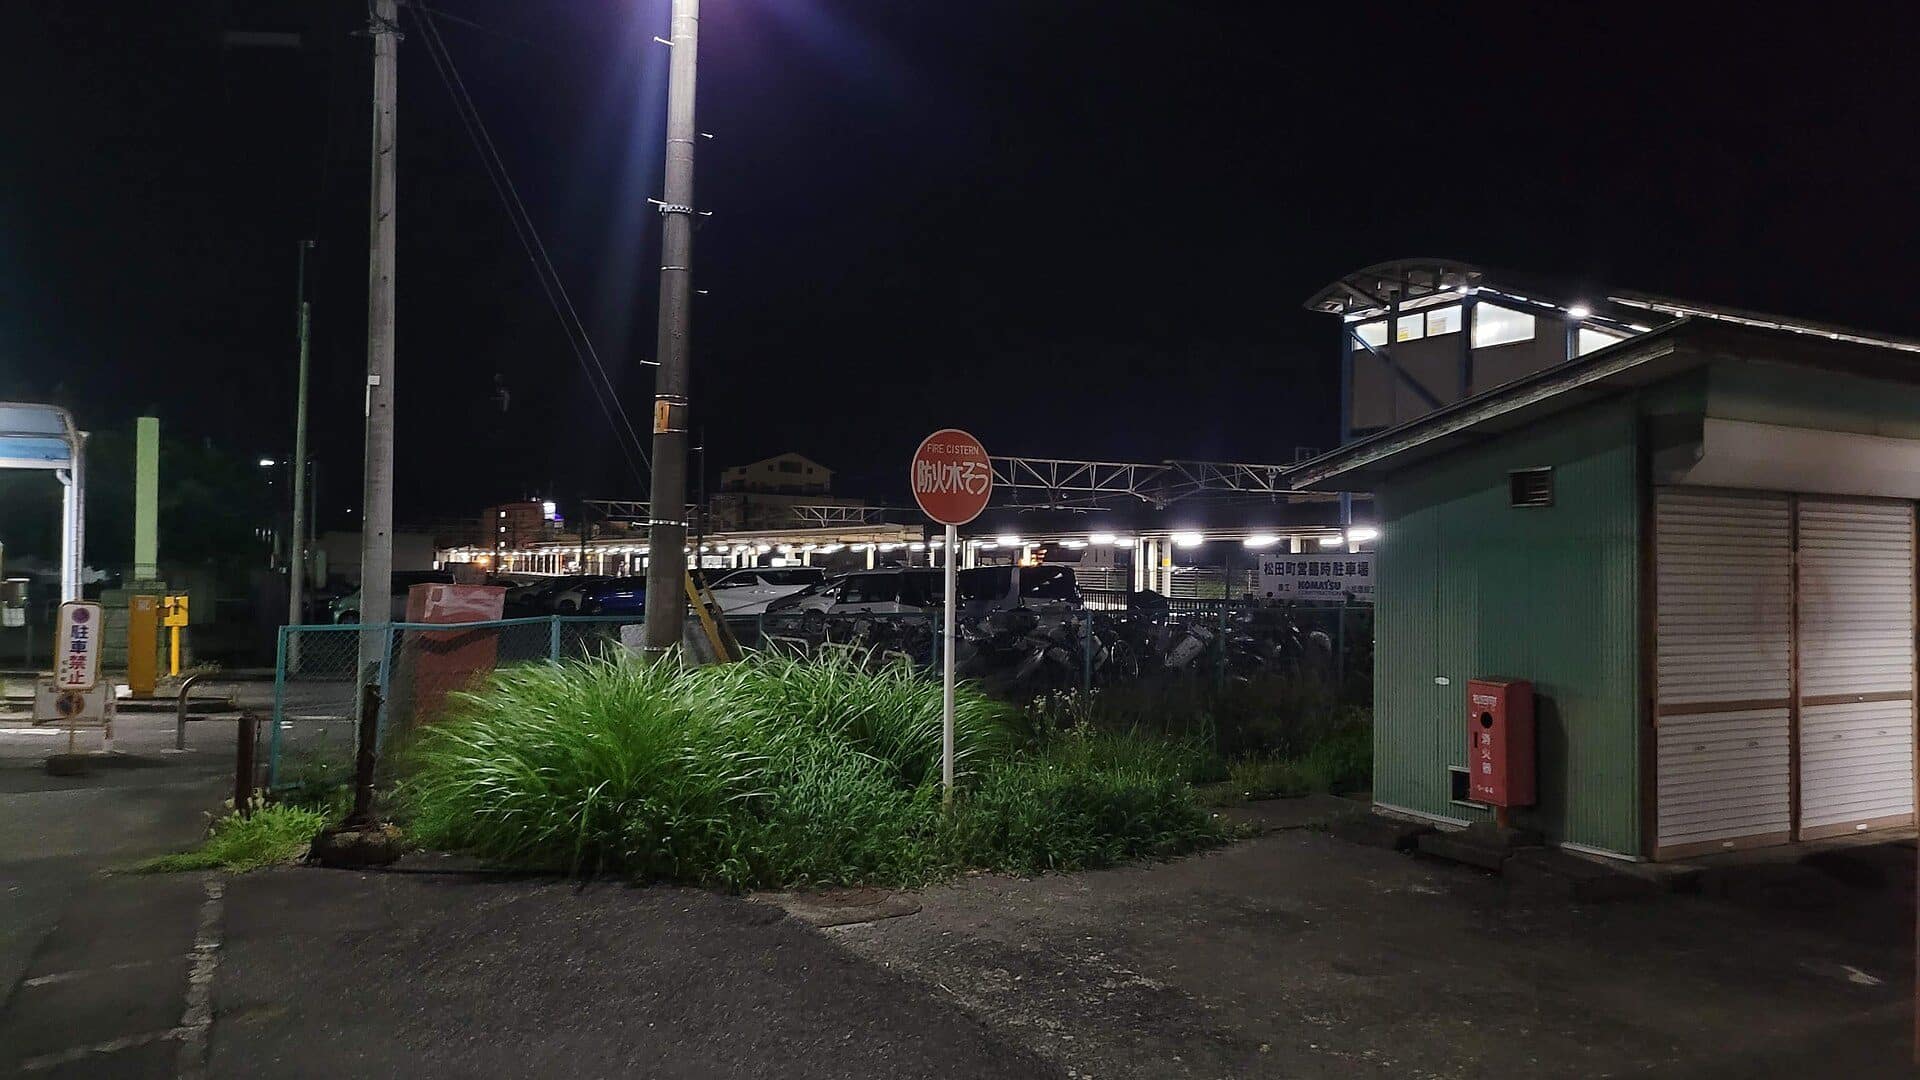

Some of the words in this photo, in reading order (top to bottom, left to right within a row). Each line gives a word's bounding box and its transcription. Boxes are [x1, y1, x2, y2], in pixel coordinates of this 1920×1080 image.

[927, 444, 944, 454] FIRE
[946, 445, 979, 455] CISTERN
[917, 459, 989, 495] 防火水そう
[1264, 561, 1369, 577] 松田町営臨時駐車場
[1298, 579, 1341, 590] KOMATSU
[67, 624, 89, 685] 駐車禁止
